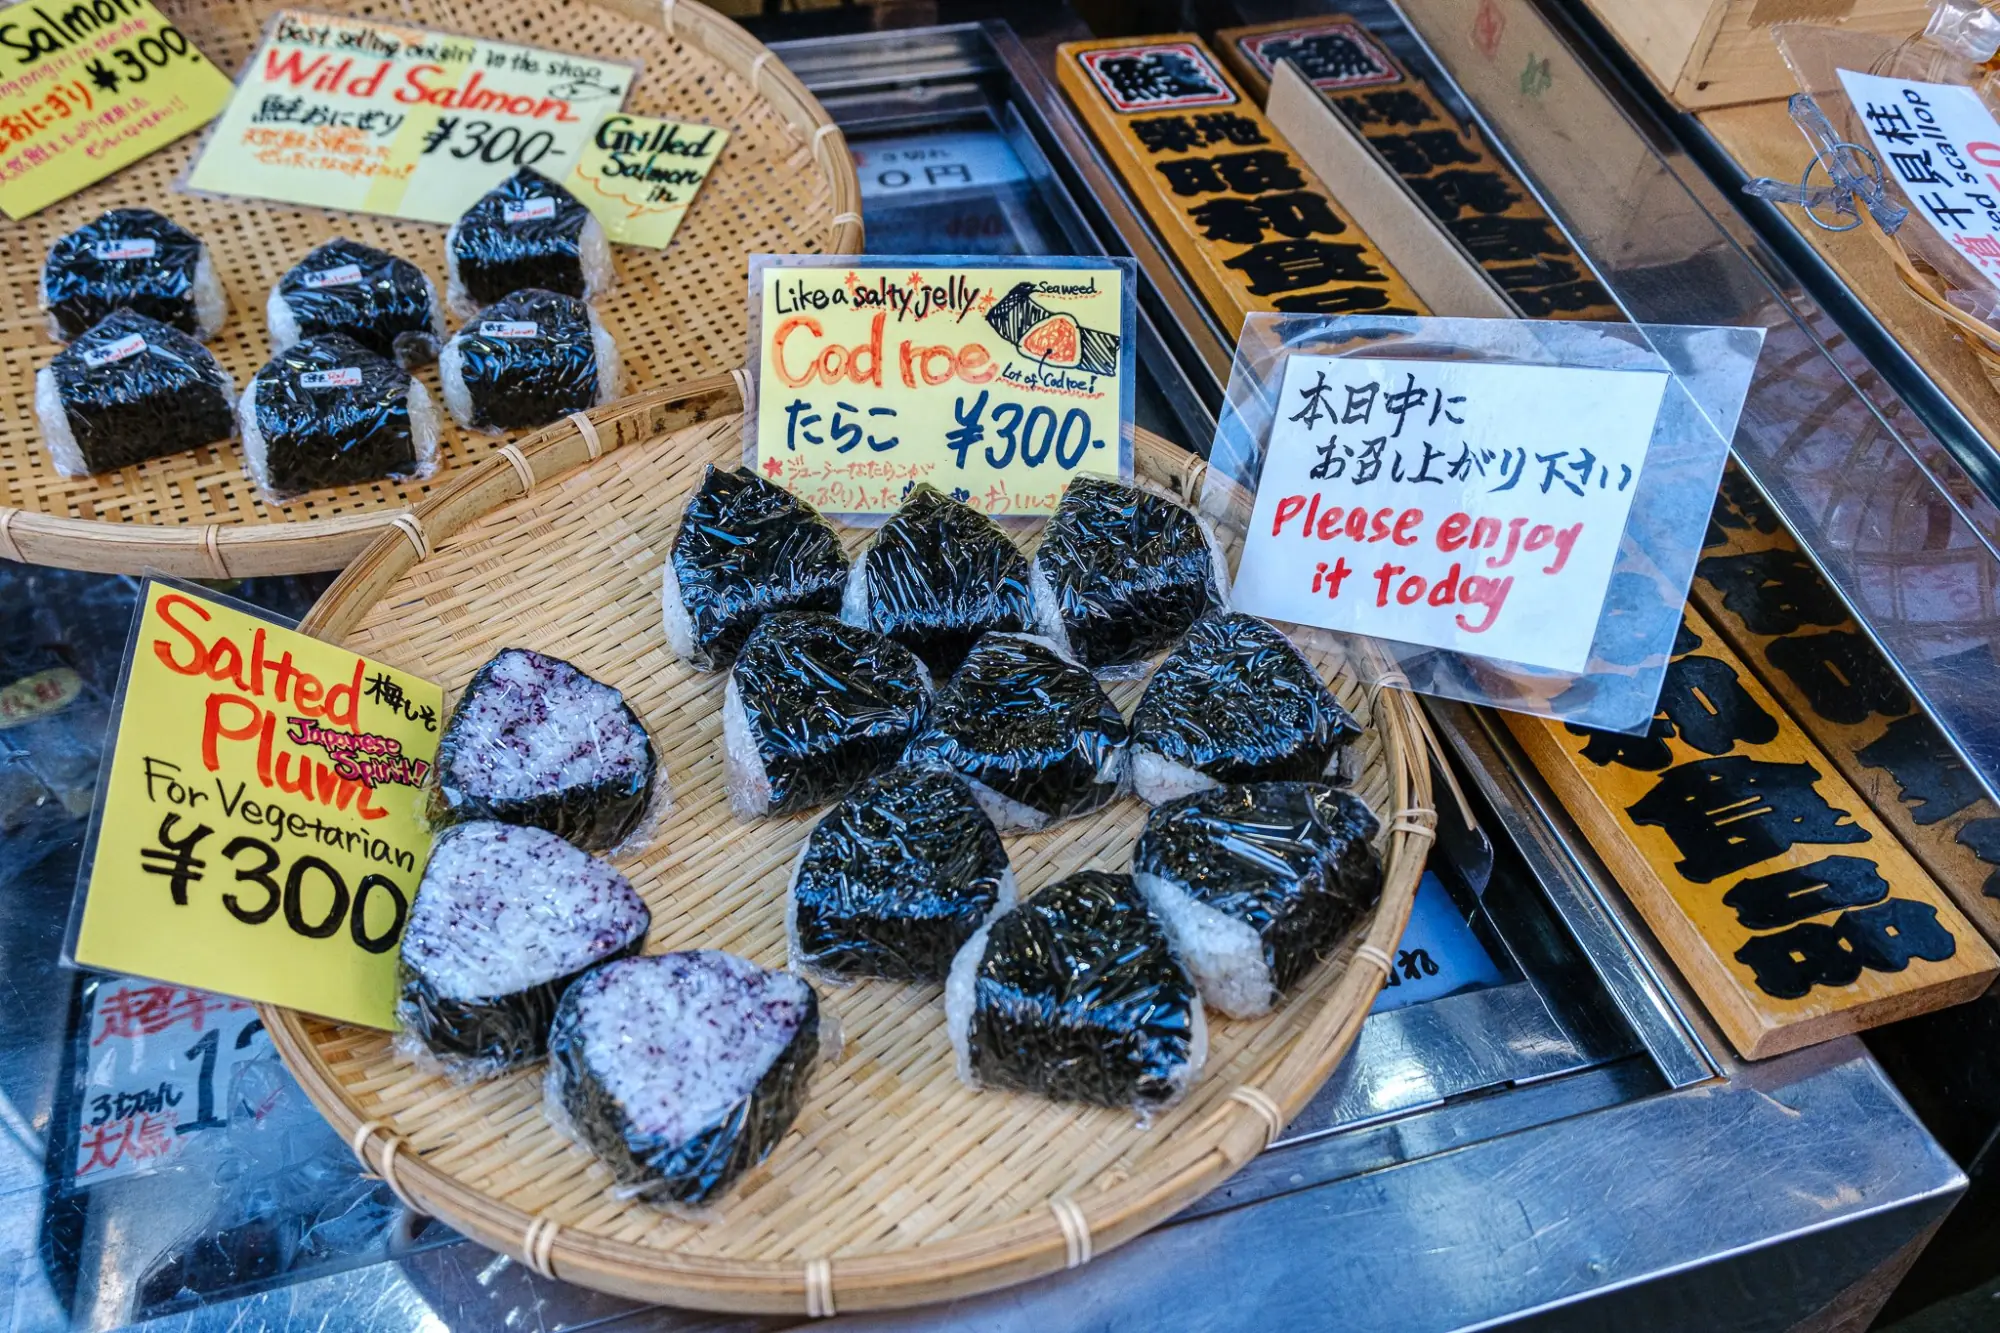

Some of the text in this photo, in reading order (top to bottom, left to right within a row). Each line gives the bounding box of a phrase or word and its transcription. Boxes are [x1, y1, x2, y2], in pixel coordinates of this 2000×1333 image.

[263, 47, 580, 123] Wild Salmon
[594, 116, 717, 157] Grilled
[601, 151, 704, 186] Salmon
[1866, 102, 1975, 231] 干貝柱
[1902, 88, 1979, 185] scallop
[776, 275, 980, 323] Like a salty jelly
[1038, 276, 1098, 294] Seaweed
[772, 311, 999, 389] Cod roe
[1002, 361, 1022, 381] Lot
[1025, 373, 1038, 391] of
[785, 398, 900, 454] たらこ
[1288, 370, 1467, 437] 本日中に
[1309, 436, 1632, 497] お召し上がり下さい
[1272, 493, 1584, 575] Please enjoy
[1311, 556, 1515, 634] it today
[153, 594, 366, 737] Salted
[287, 716, 402, 758] Japanese
[364, 672, 438, 732] 梅しそ
[200, 693, 389, 821] Plum
[142, 756, 415, 874] For Vegetarian
[141, 811, 408, 955] ¥300
